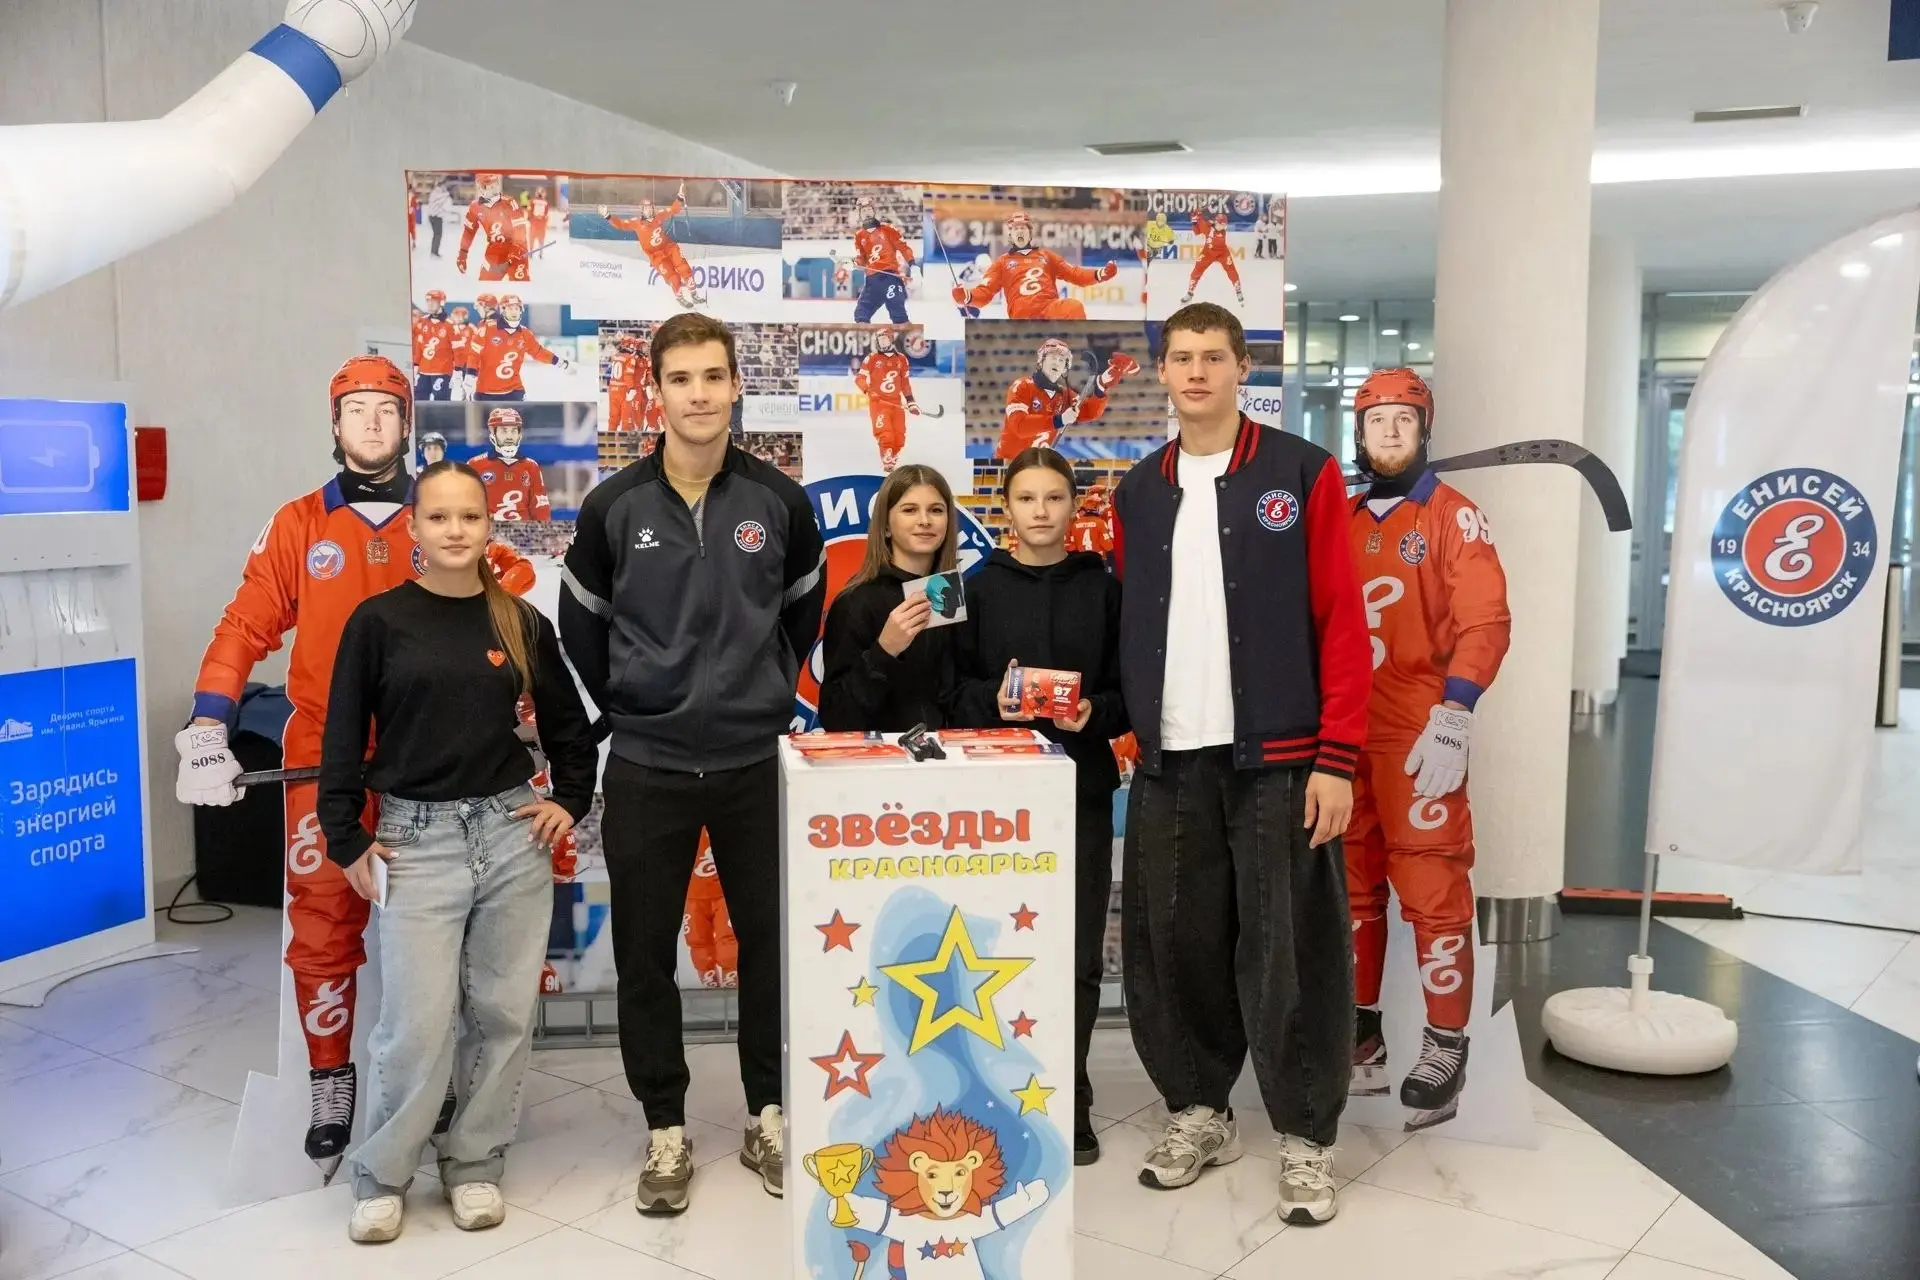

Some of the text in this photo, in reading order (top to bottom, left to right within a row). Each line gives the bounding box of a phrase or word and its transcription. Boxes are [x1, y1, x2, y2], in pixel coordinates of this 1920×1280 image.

[1261, 492, 1294, 505] ЕНИСЕЙ
[1731, 474, 1865, 521] ЕНИСЕЙ
[634, 541, 660, 549] KELME
[1717, 539, 1737, 554] 19
[1852, 541, 1870, 557] 34
[1724, 568, 1858, 618] КРАСНОЯРСК
[50, 704, 115, 723] Дворец спорта
[1433, 733, 1463, 751] 8088
[191, 753, 226, 769] 8088
[9, 768, 118, 805] Зарядись
[15, 795, 116, 838] энергией
[808, 802, 1031, 850] ЗВЁЗДЫ
[30, 834, 105, 867] спорта
[829, 851, 1057, 880] КРАСНОЯРЬЯ
